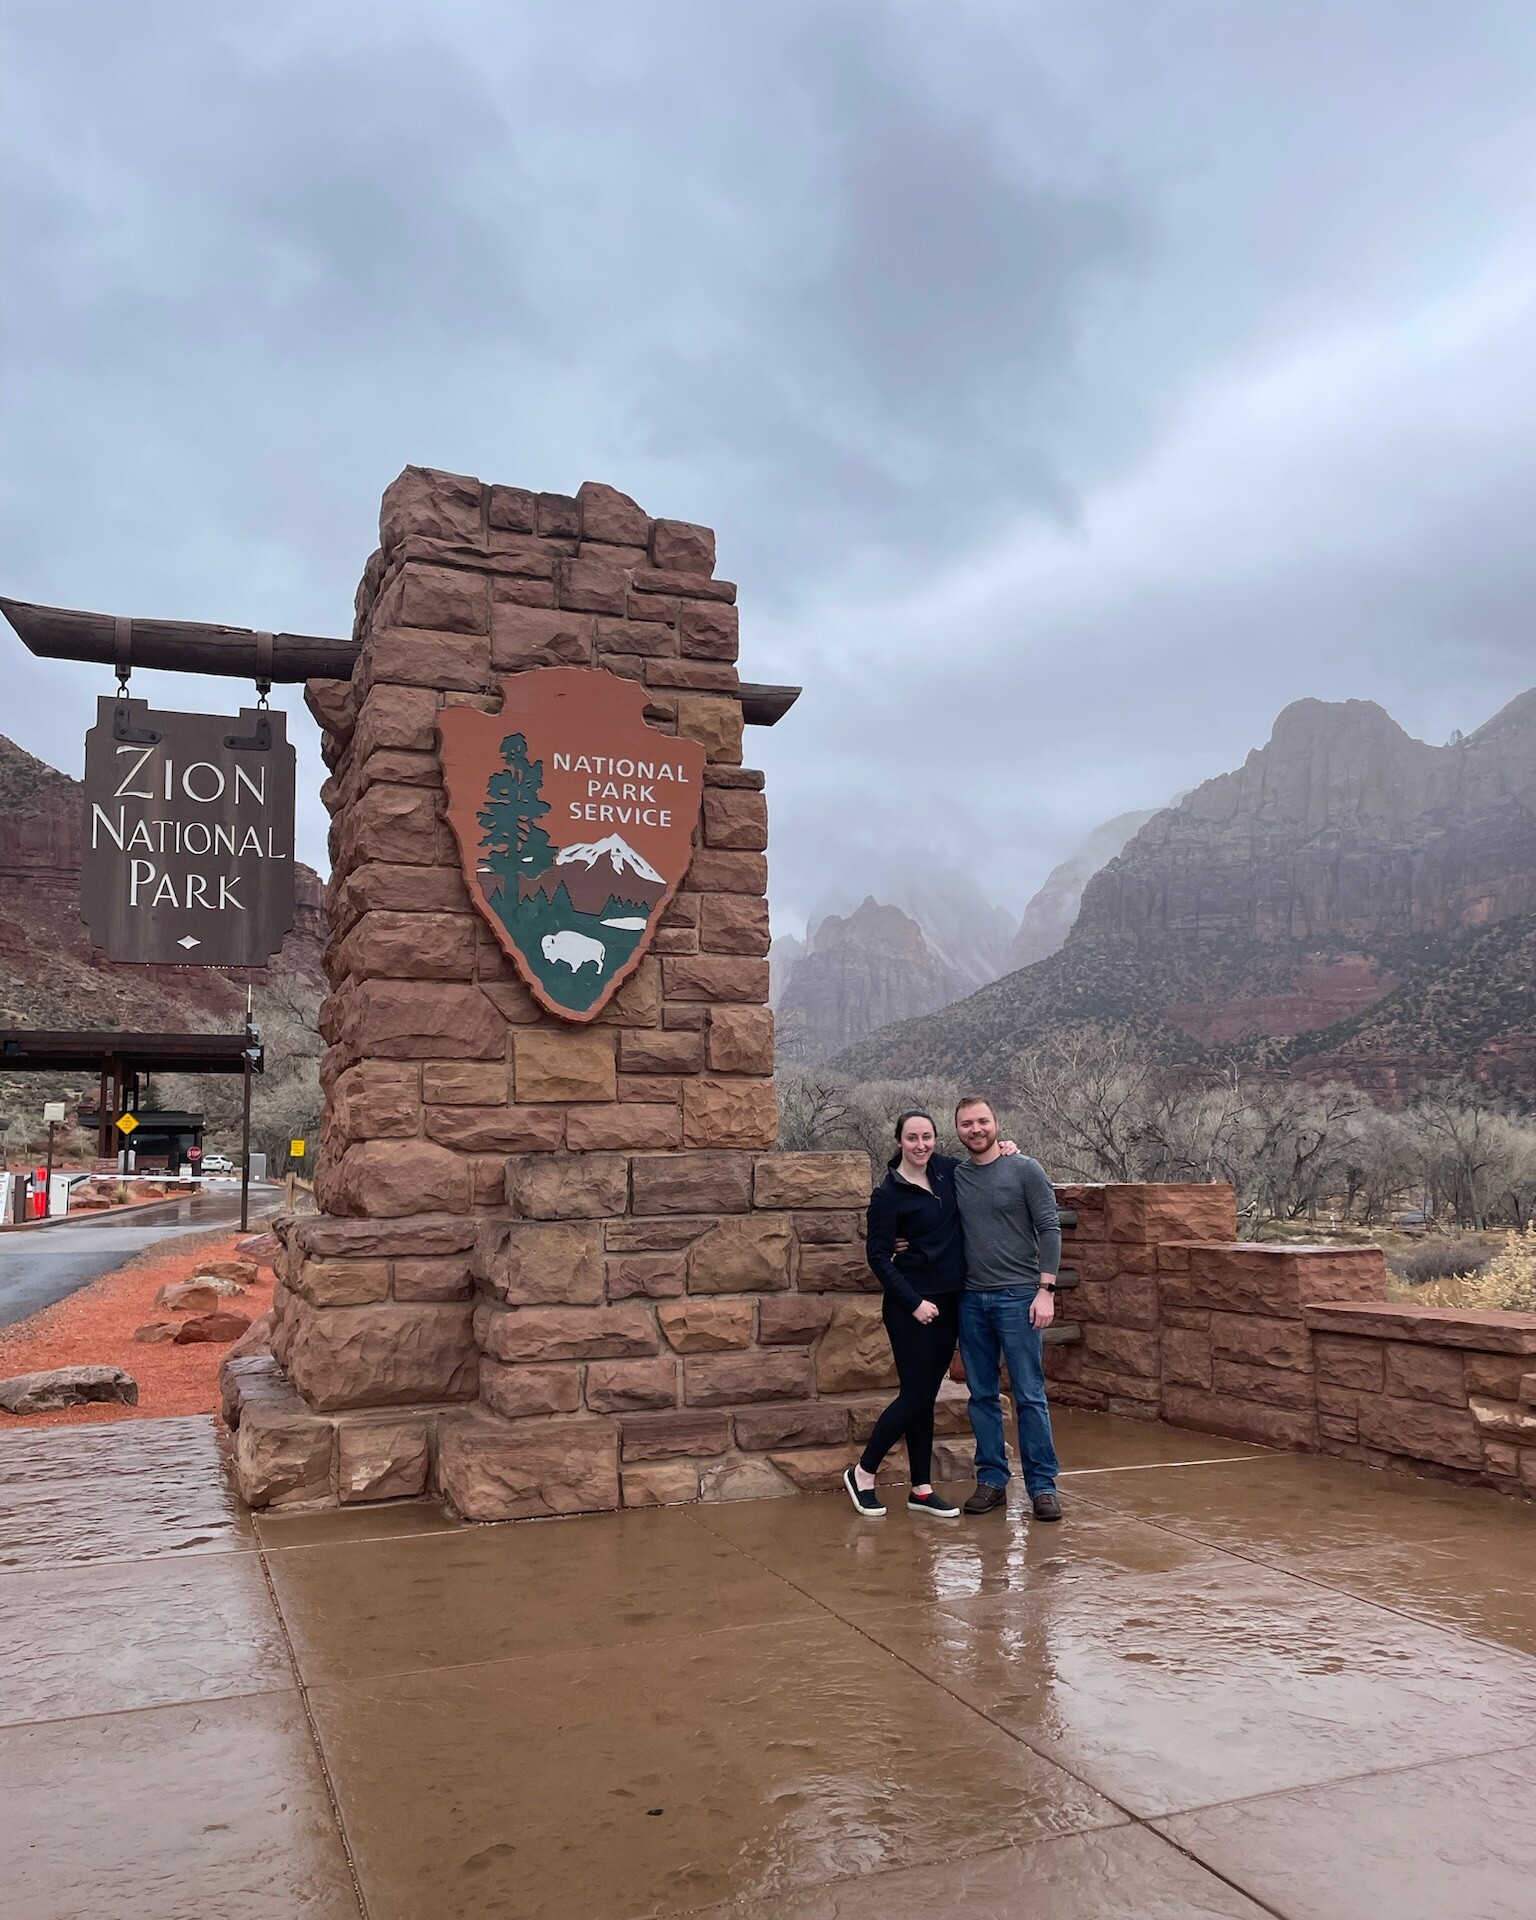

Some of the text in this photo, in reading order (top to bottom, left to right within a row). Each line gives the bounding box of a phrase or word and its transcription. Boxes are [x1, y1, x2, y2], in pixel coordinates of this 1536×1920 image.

[113, 745, 265, 805] ZION
[553, 752, 689, 783] NATIONAL
[587, 780, 656, 803] PARK
[92, 802, 286, 859] NATIONAL
[569, 802, 672, 828] SERVICE
[129, 859, 246, 910] PARK
